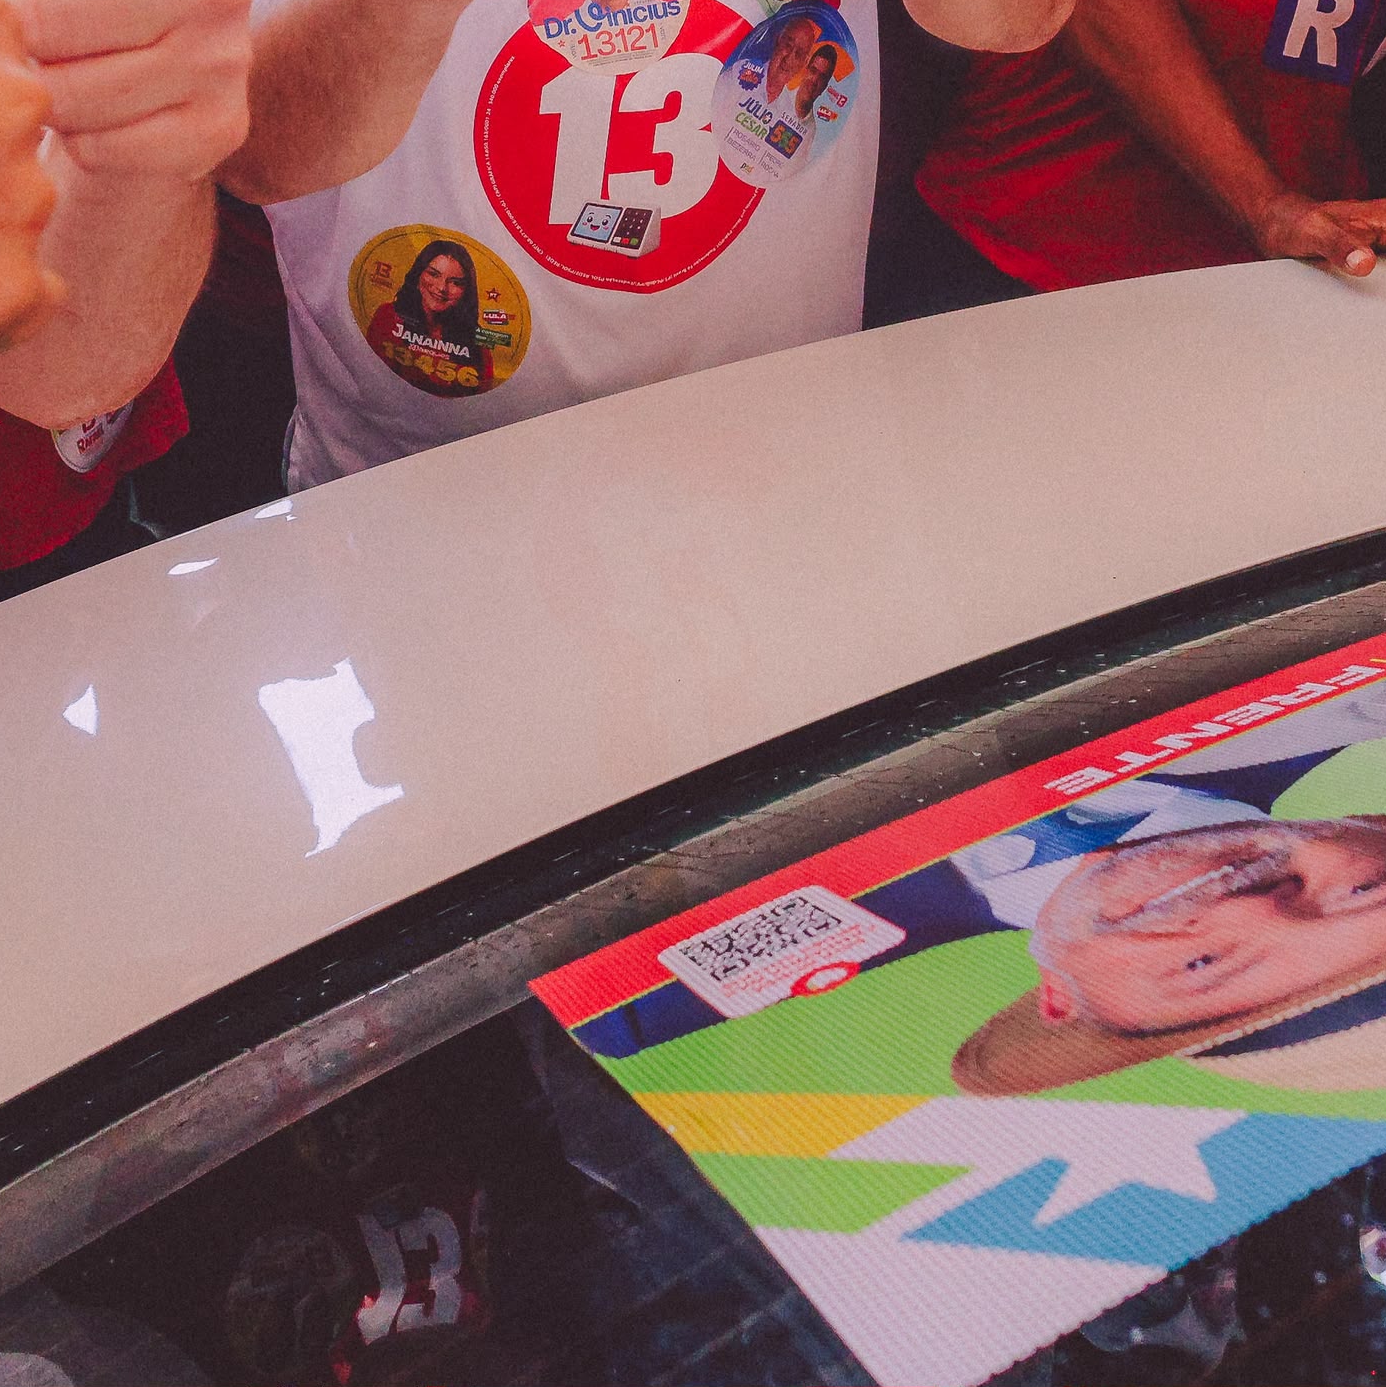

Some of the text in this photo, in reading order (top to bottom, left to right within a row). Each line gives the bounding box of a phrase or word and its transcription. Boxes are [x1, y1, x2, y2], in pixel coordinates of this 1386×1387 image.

[543, 17, 577, 39] Dr.
[577, 23, 660, 60] 13.121
[738, 97, 774, 125] JÚLIO
[781, 112, 808, 136] SENADOR
[539, 53, 720, 224] 13
[483, 313, 508, 321] LULA
[391, 323, 471, 359] JANAINNA
[1044, 664, 1383, 795] FRENTE
